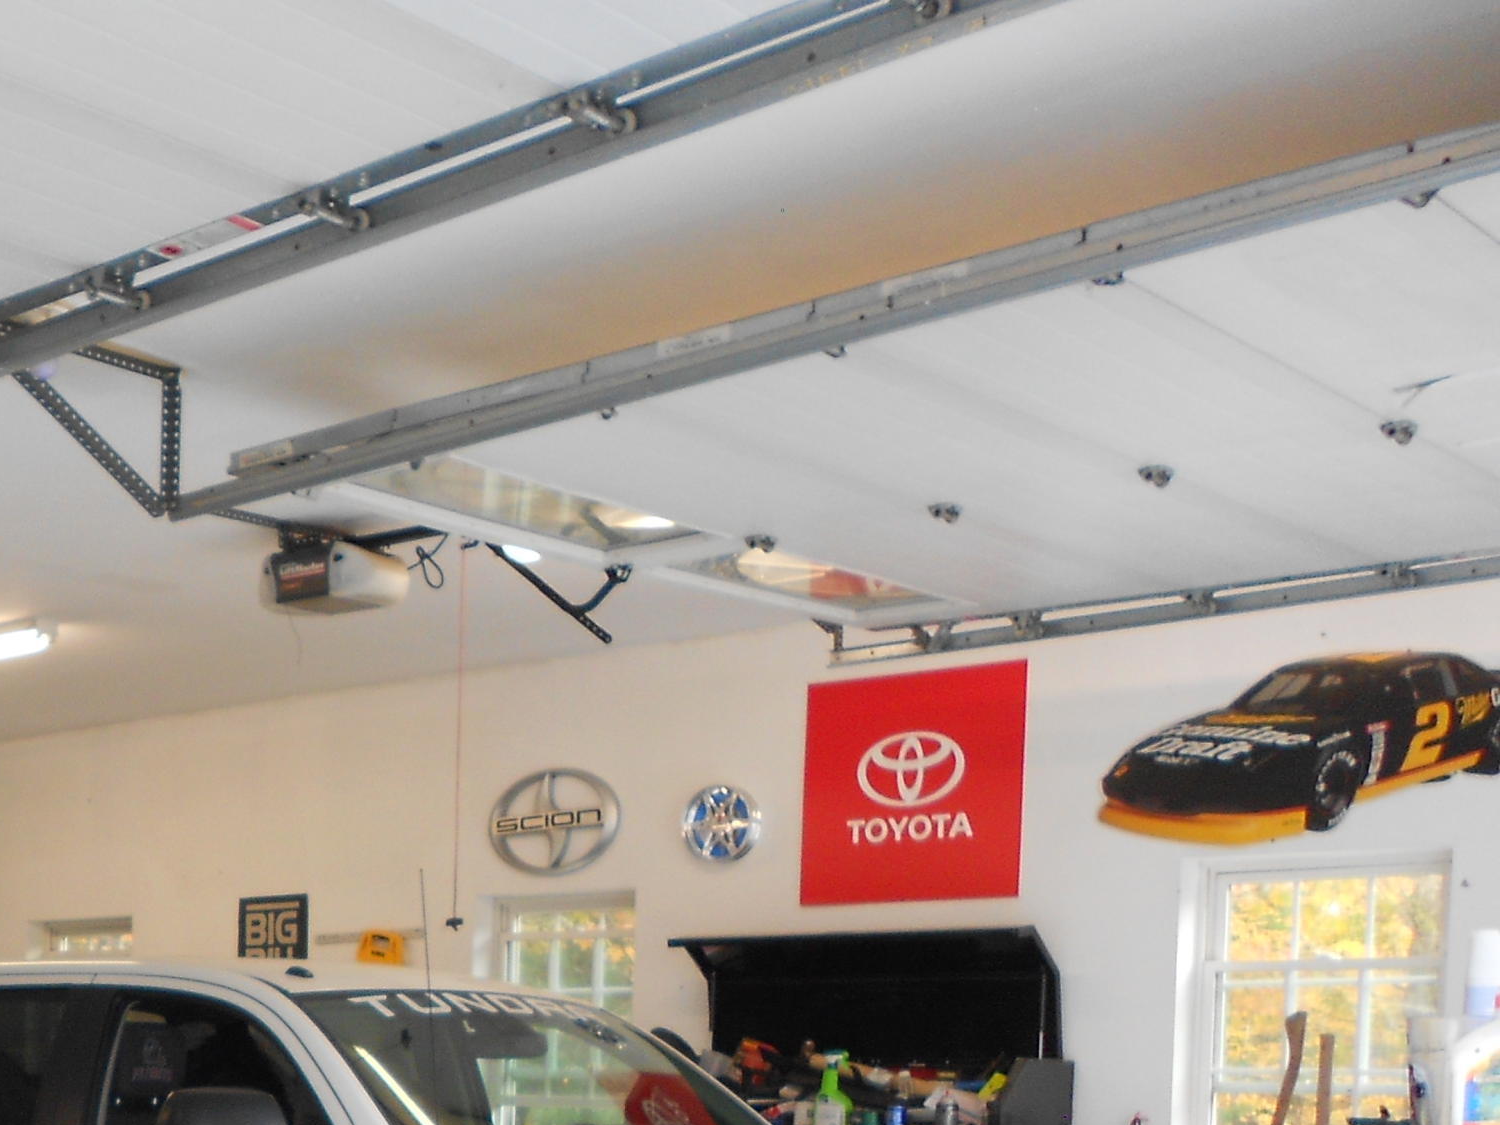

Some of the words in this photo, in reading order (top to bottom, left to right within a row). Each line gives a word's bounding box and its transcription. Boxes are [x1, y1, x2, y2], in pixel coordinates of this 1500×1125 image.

[1400, 701, 1452, 772] 2
[496, 808, 602, 833] SCION
[846, 811, 974, 845] TOYOTA
[245, 910, 298, 946] BIG
[347, 992, 603, 1024] TUNDRA
